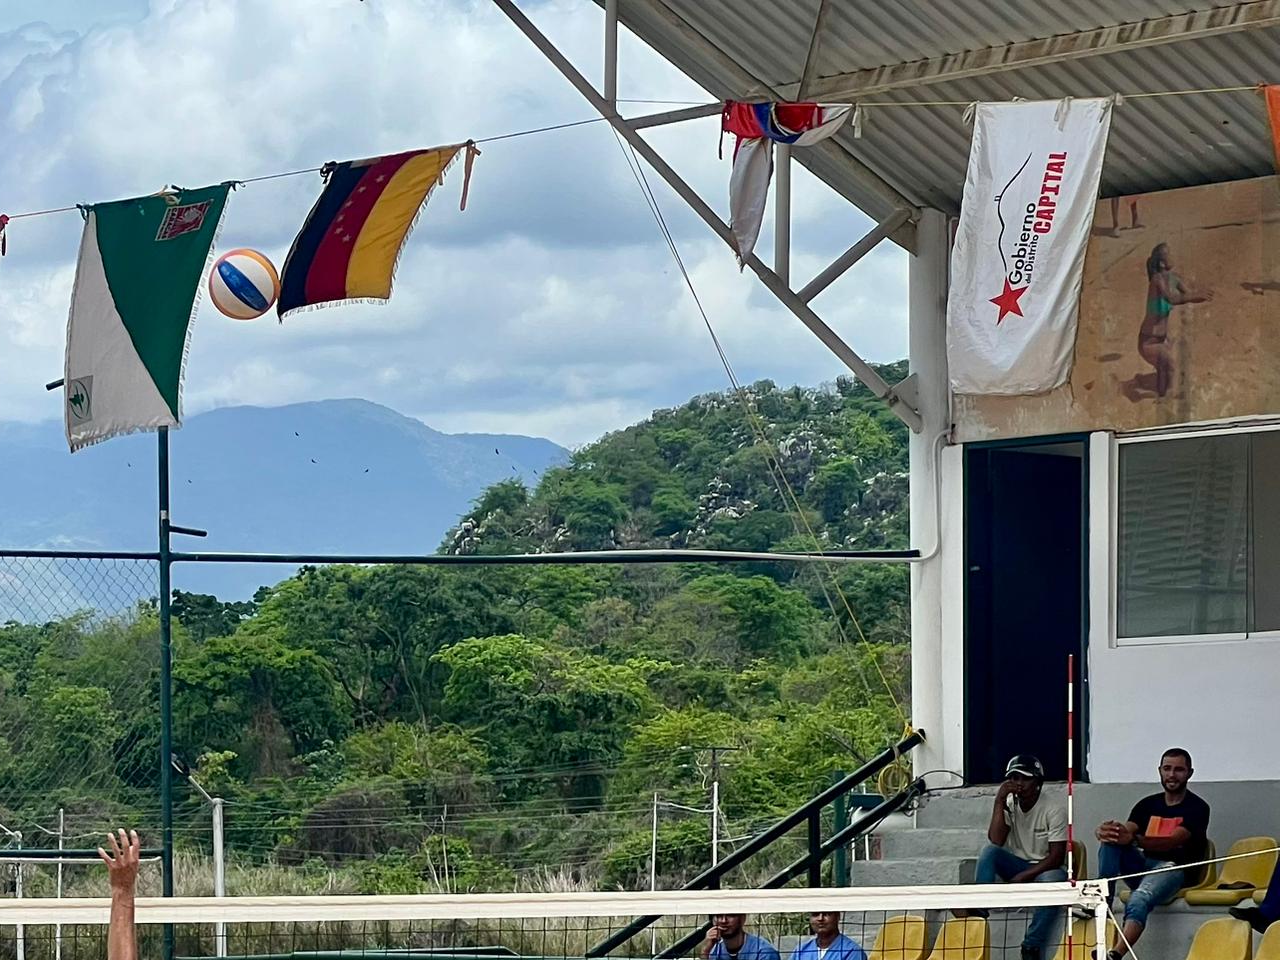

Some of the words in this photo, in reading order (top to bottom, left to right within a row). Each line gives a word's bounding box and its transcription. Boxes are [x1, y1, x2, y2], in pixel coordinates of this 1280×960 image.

[1033, 152, 1067, 234] CAPITAL
[1009, 203, 1036, 284] Gobierno
[1024, 234, 1039, 271] Distrito
